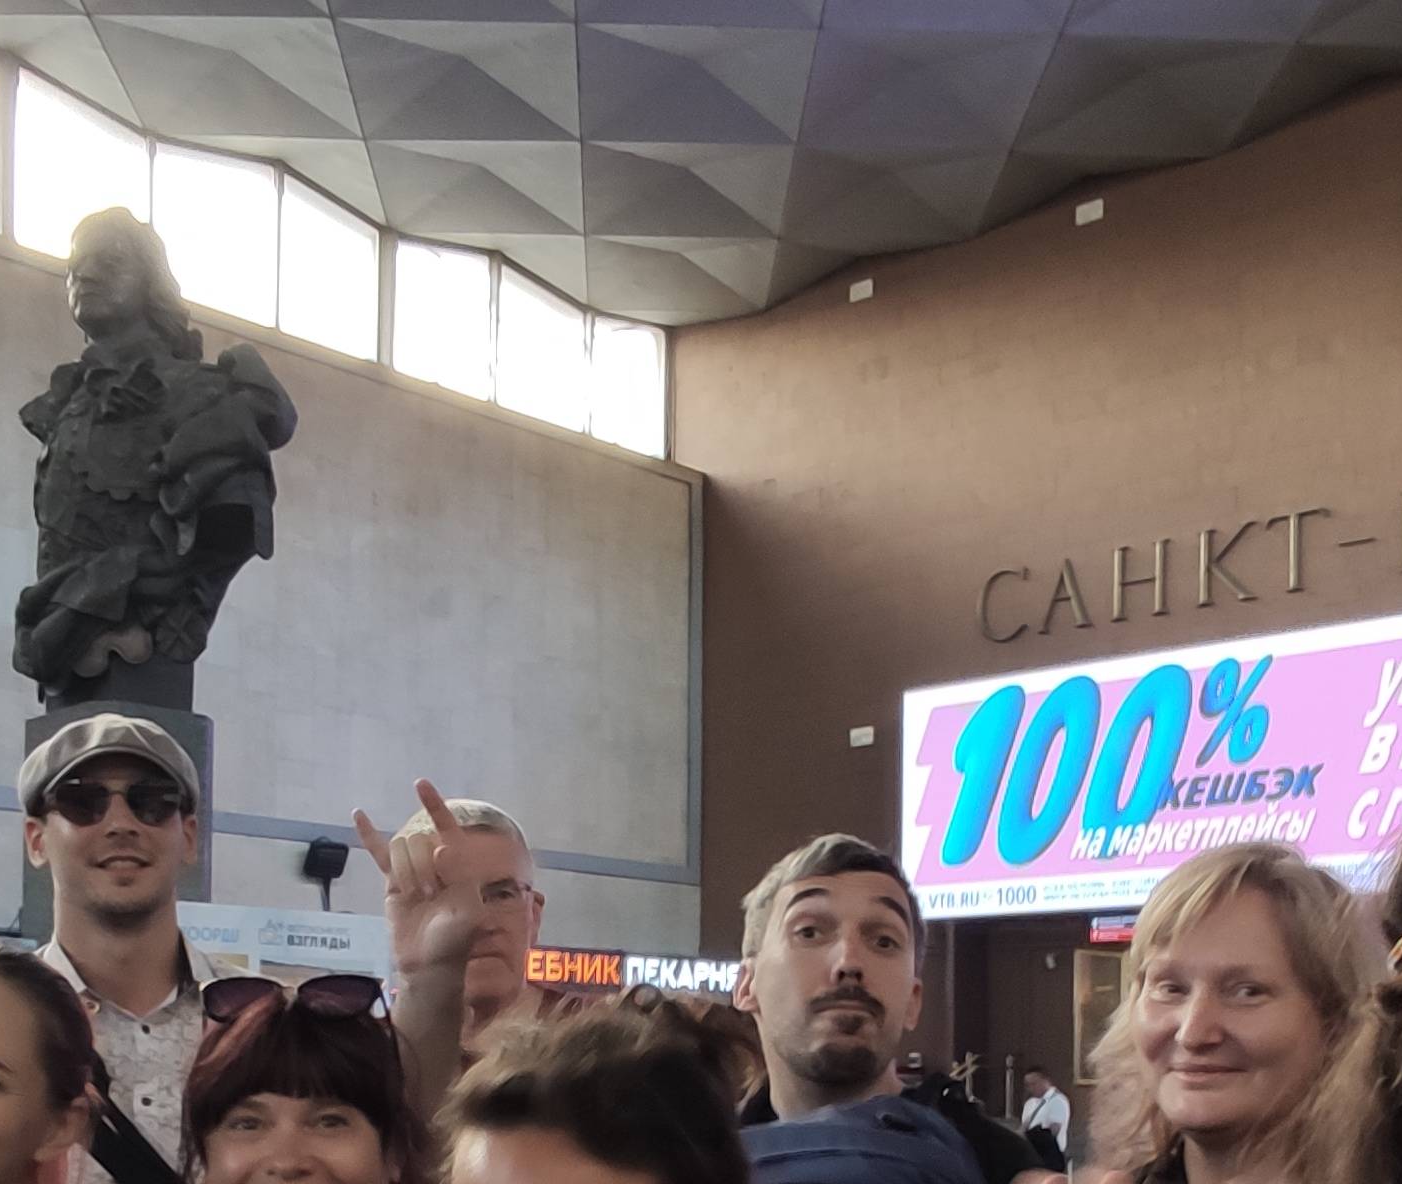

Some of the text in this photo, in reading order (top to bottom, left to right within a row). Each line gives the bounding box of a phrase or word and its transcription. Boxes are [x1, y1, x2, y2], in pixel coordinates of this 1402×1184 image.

[940, 652, 1274, 868] 100%
[1358, 722, 1398, 775] в
[1069, 801, 1318, 864] на маркетплейсы
[997, 884, 1037, 907] 1000
[286, 933, 352, 951] ВЗГЛЯДЫ
